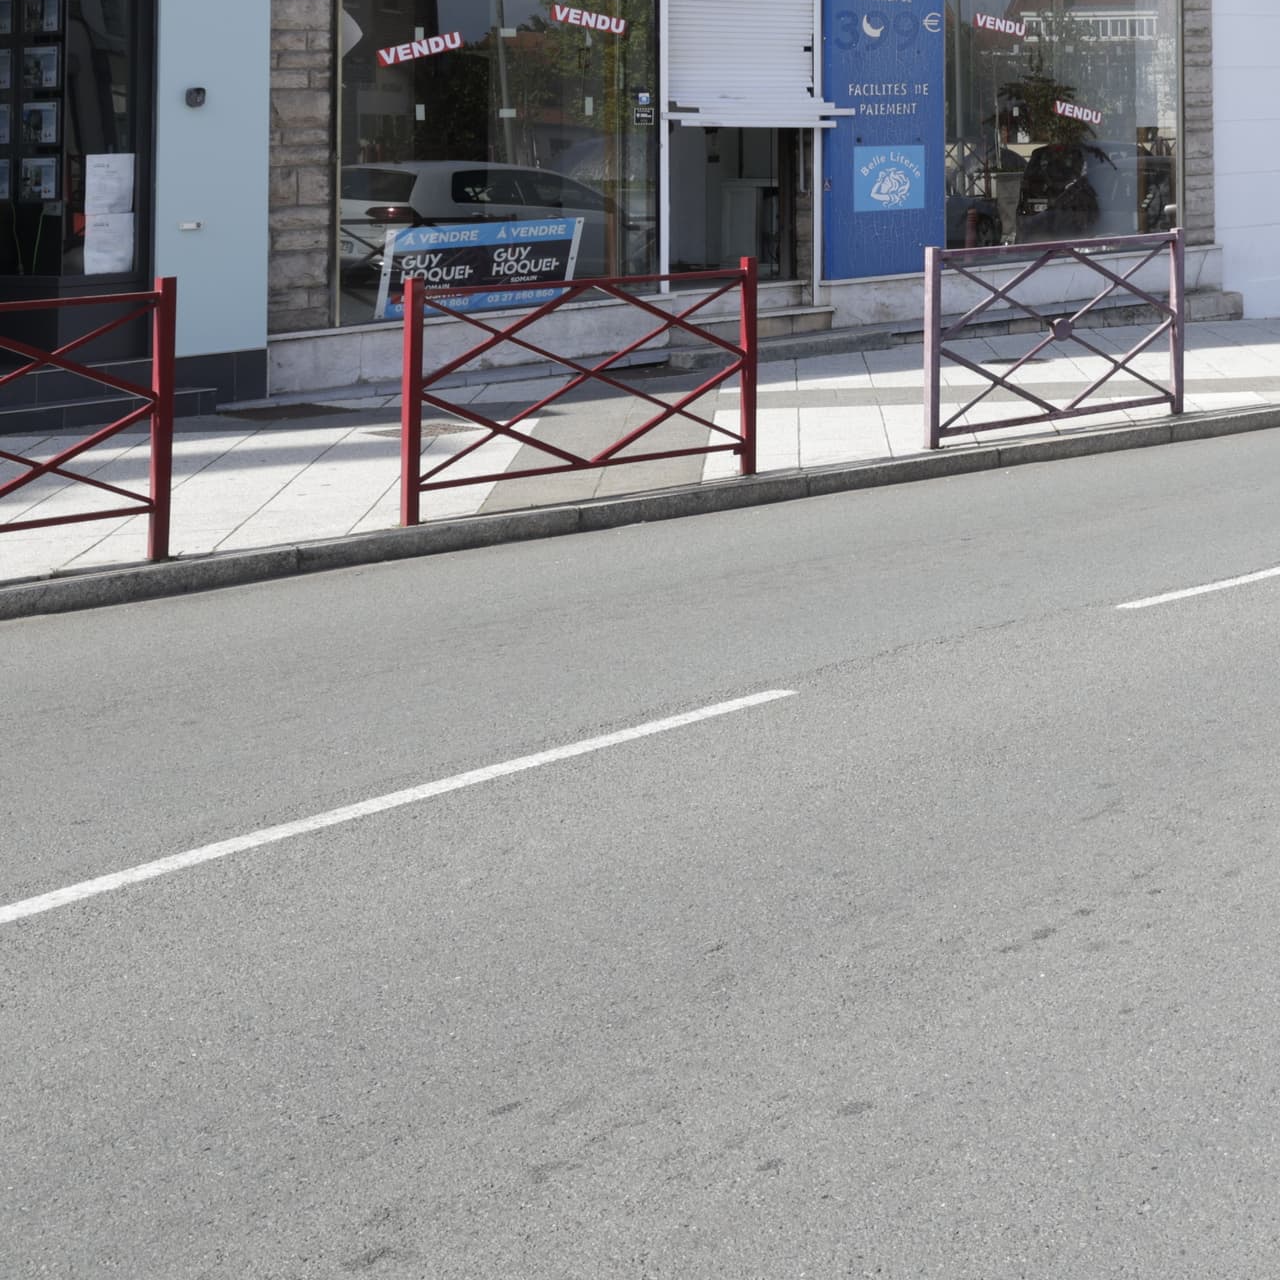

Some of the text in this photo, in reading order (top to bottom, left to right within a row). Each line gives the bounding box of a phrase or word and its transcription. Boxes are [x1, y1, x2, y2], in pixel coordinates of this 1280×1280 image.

[553, 5, 626, 33] VENDU
[976, 13, 1026, 37] VENDU
[379, 32, 462, 66] VENDU
[848, 83, 907, 96] FACILITES
[859, 102, 917, 116] PAIEMENT
[1055, 100, 1102, 125] VENDU
[860, 151, 921, 177] Belle Literie
[419, 229, 480, 244] VENDRE
[511, 224, 567, 238] VENDRE
[401, 253, 443, 270] GUY
[493, 246, 532, 262] GUY
[491, 257, 560, 276] HOQUET
[510, 275, 538, 283] SOMAIN
